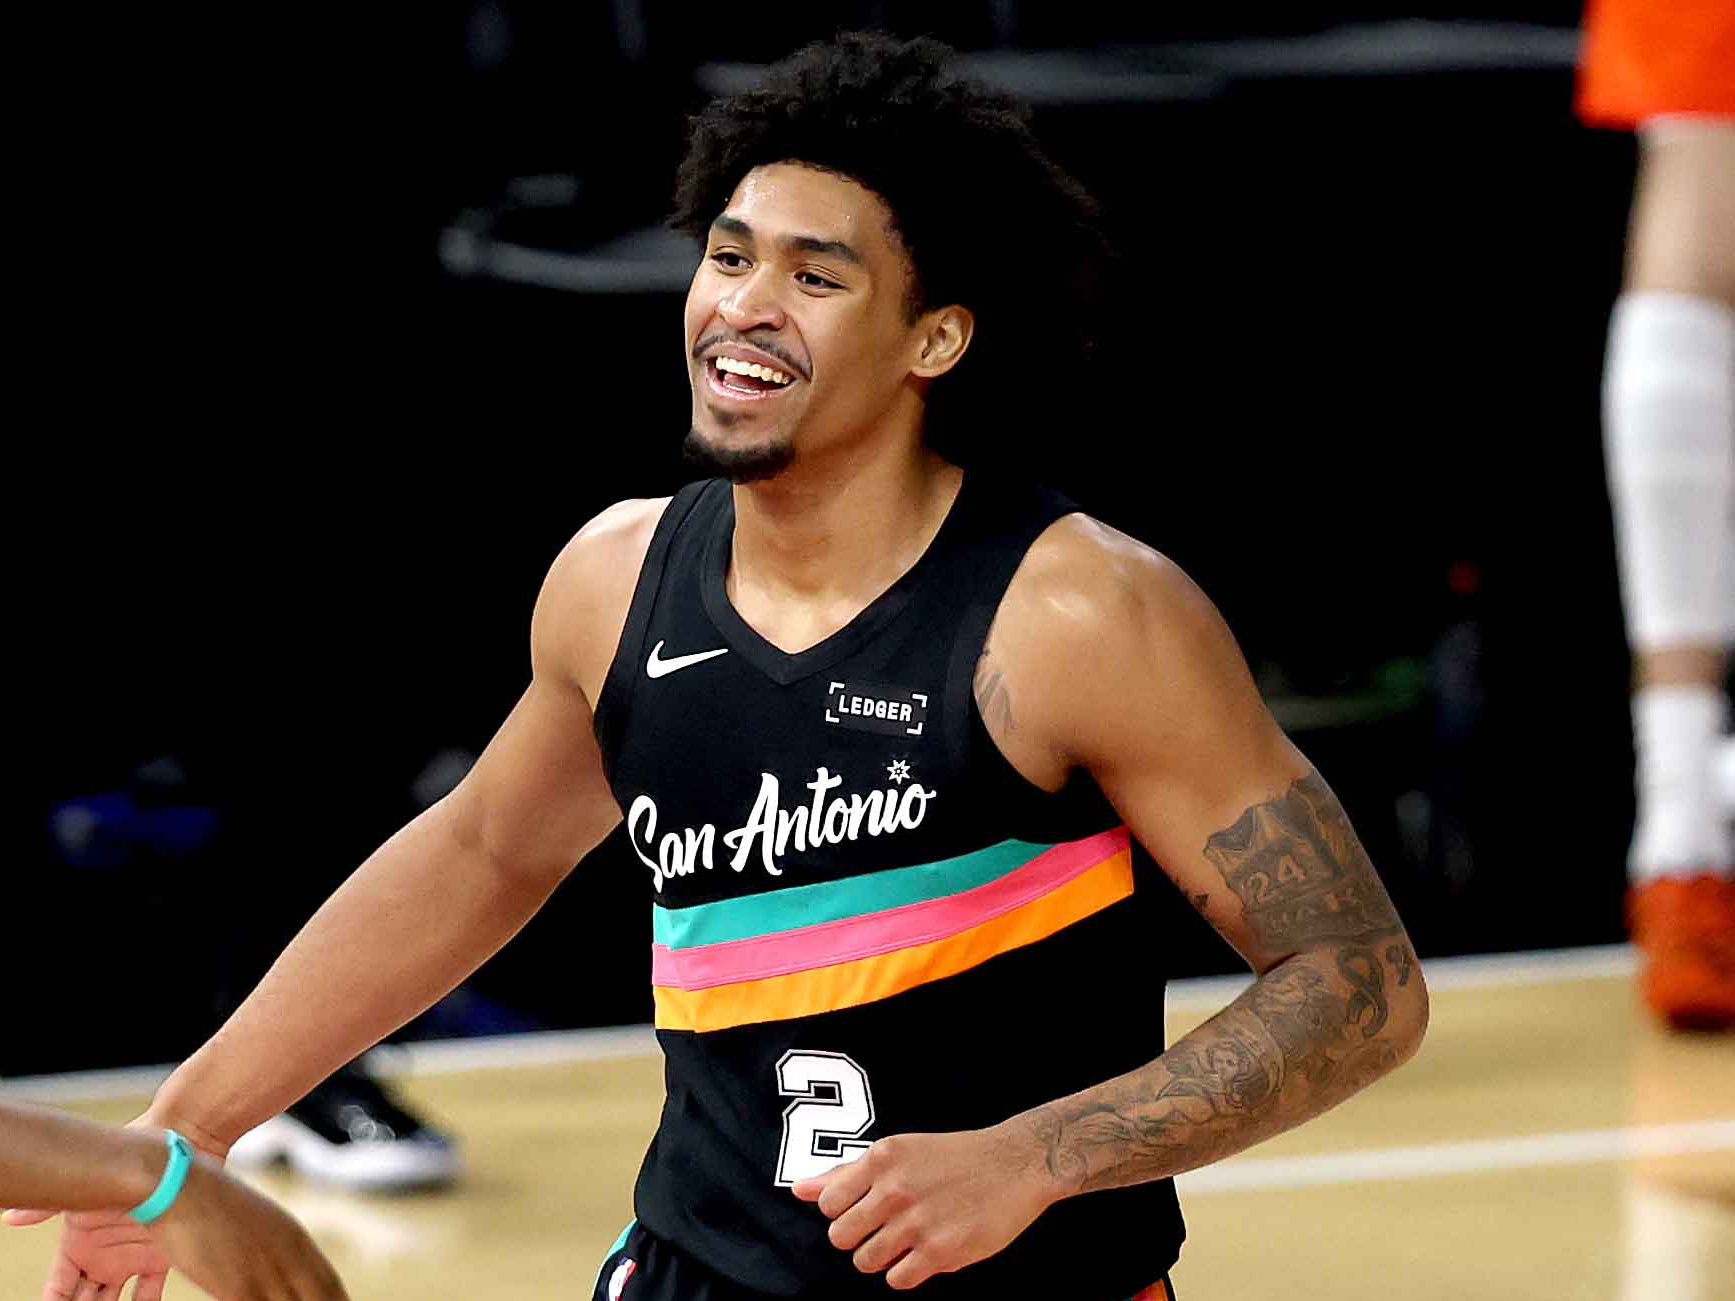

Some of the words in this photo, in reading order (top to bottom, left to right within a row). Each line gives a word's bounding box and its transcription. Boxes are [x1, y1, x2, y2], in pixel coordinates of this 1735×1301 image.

[838, 694, 913, 722] LEDGER
[627, 794, 716, 894] San
[722, 759, 937, 876] Antonio
[774, 1049, 875, 1188] 2
